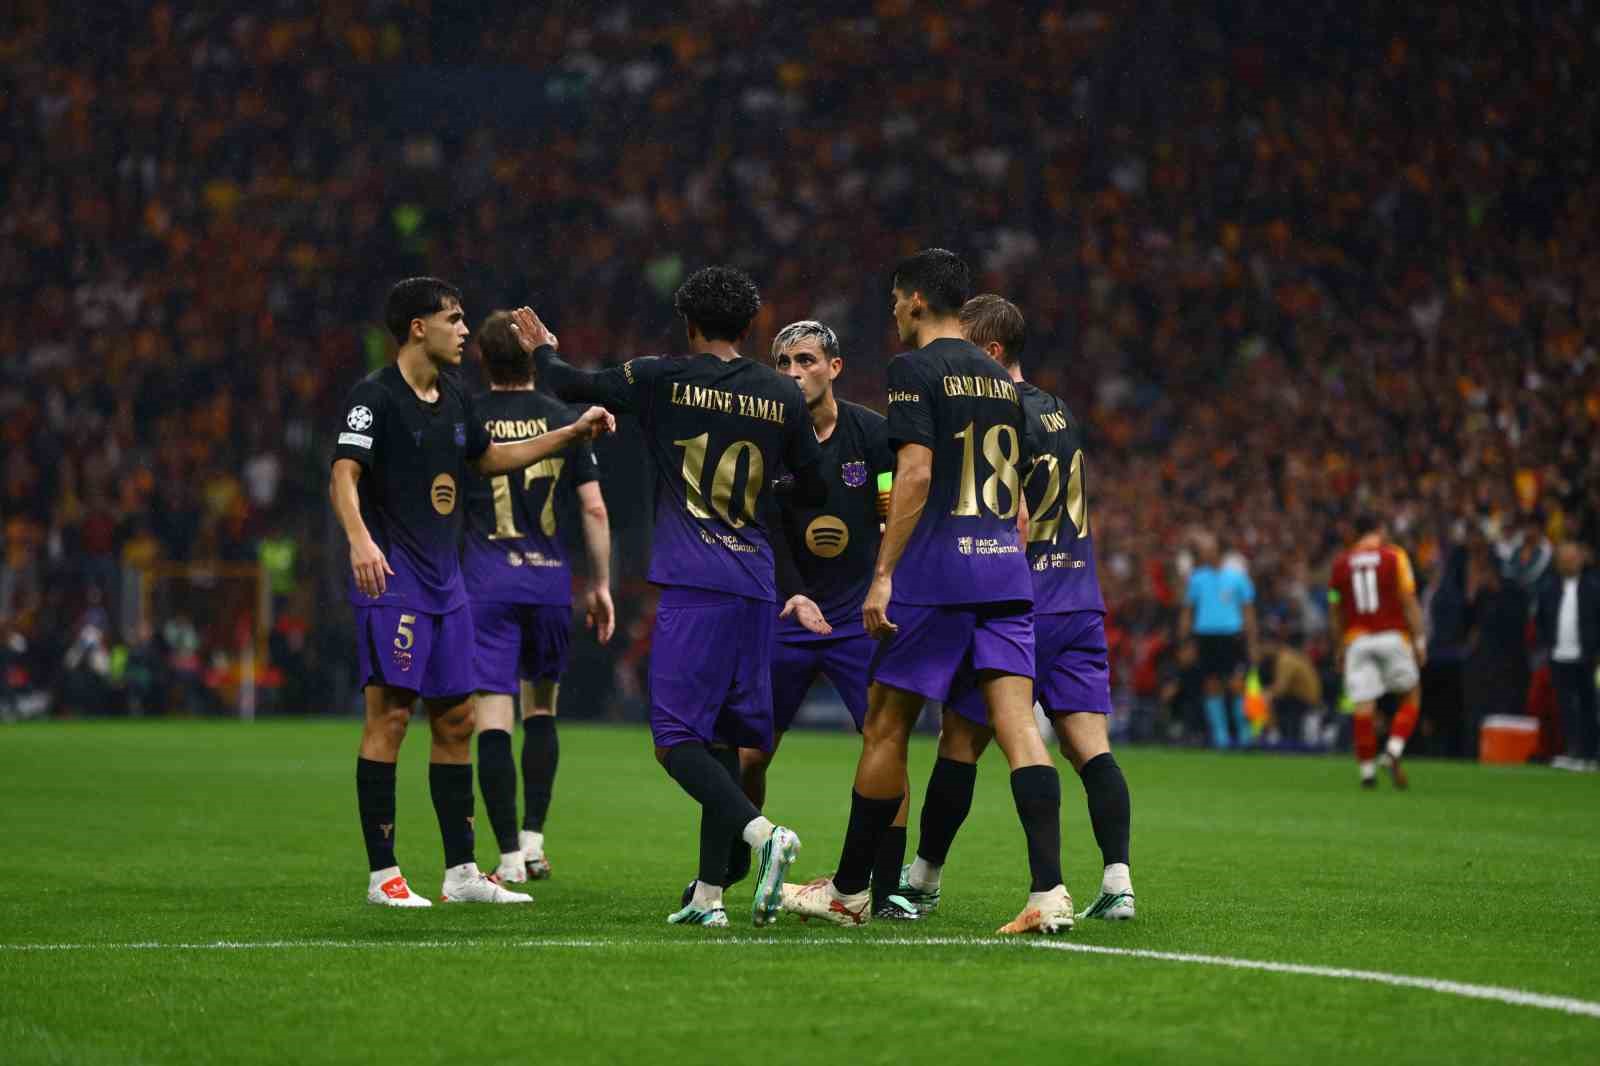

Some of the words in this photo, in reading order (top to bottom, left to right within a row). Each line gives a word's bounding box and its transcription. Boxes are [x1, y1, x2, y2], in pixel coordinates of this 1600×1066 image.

[485, 417, 548, 438] GORDON
[671, 382, 733, 414] LAMINE
[738, 394, 785, 424] YAMAL
[488, 457, 565, 541] 17
[673, 431, 764, 529] 10
[951, 421, 1019, 520] 18
[1023, 448, 1088, 546] 20
[1352, 567, 1379, 614] 11
[394, 614, 416, 649] 5
